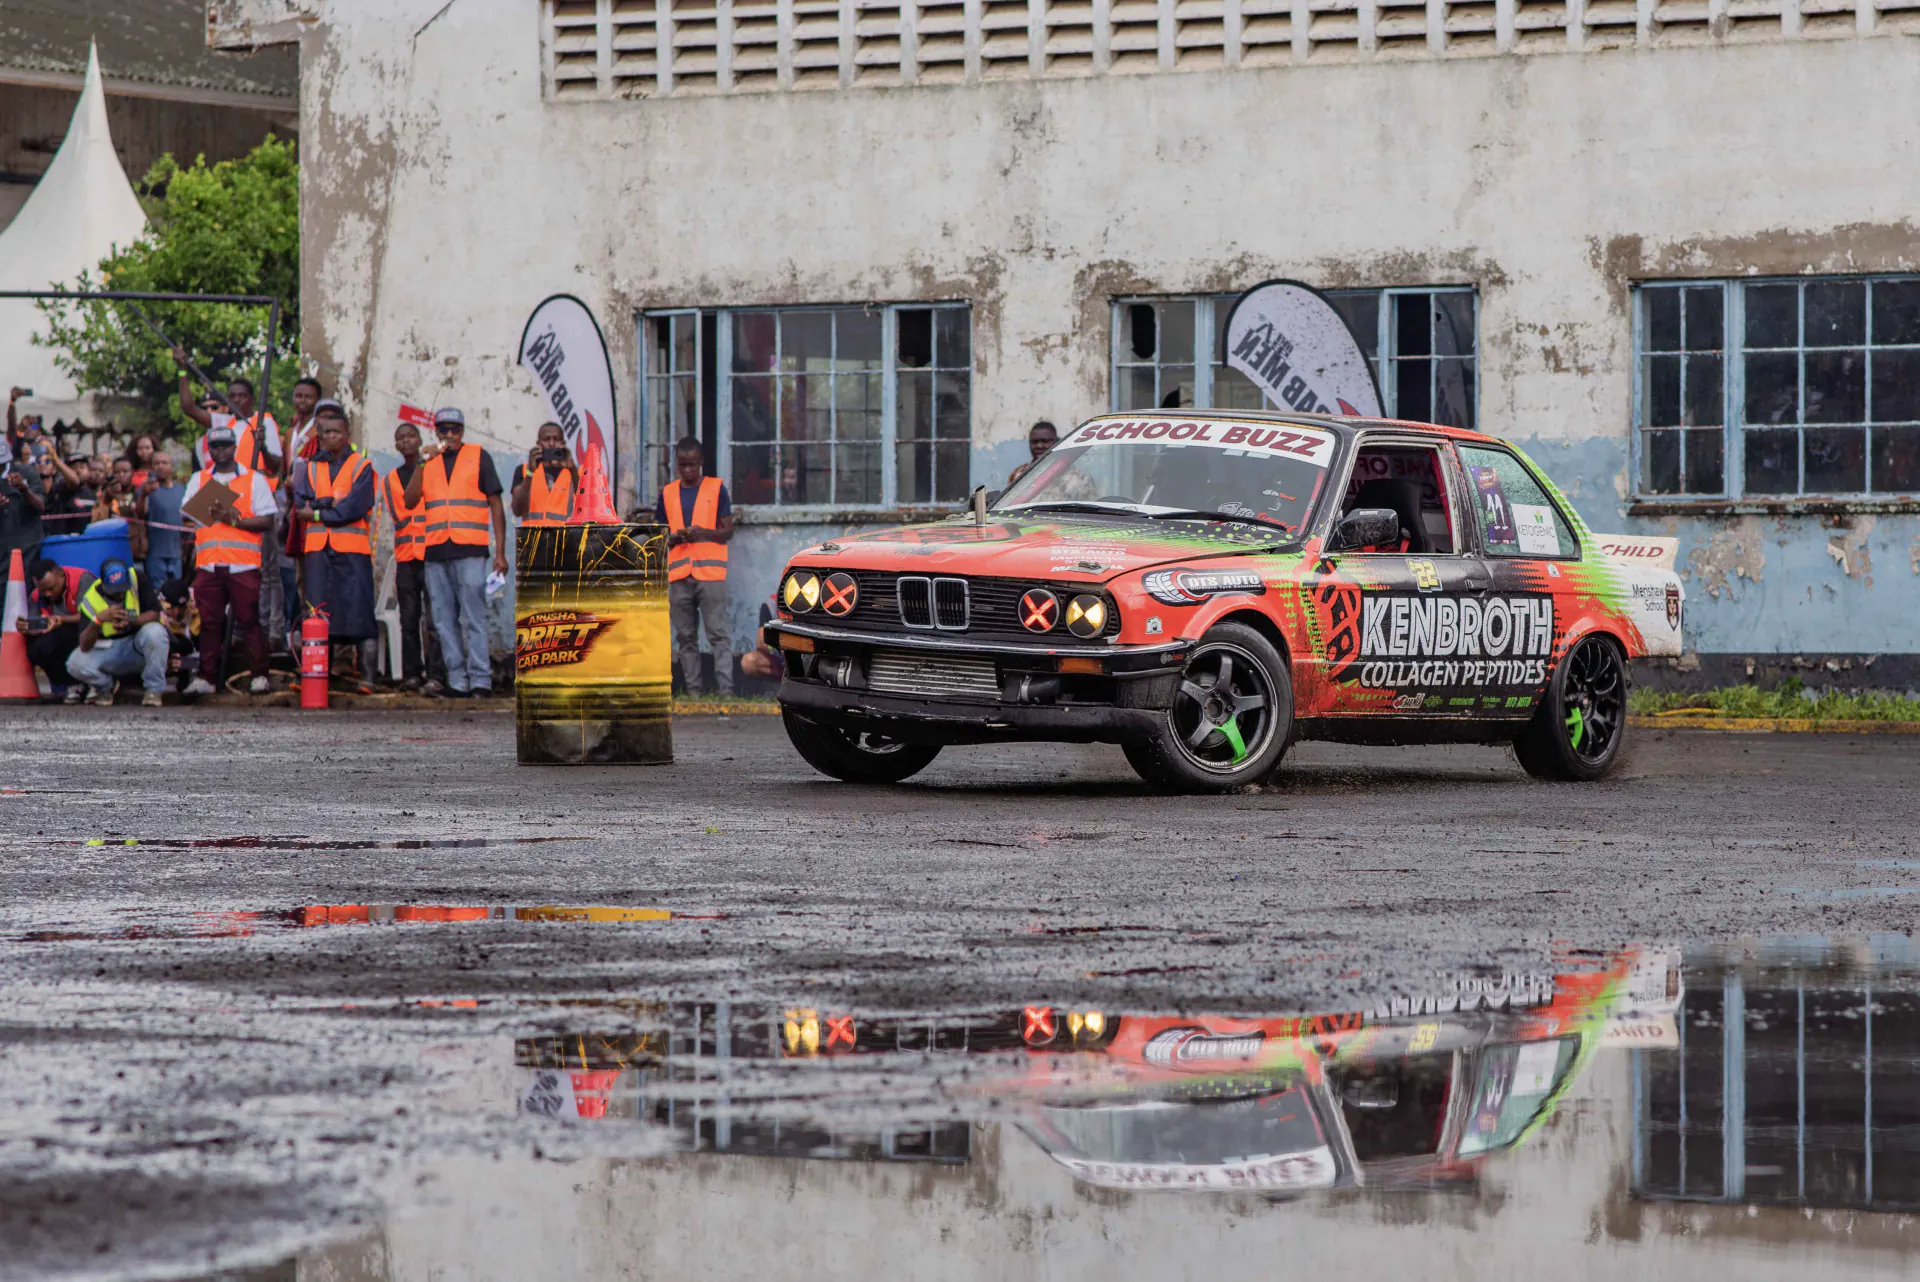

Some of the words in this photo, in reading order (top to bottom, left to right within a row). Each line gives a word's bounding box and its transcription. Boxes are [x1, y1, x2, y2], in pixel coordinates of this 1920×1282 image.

[1074, 422, 1212, 443] SCHOOL
[1219, 426, 1326, 457] BUZZ
[1187, 577, 1217, 587] DTS
[1222, 575, 1260, 585] AUTO
[1632, 584, 1665, 597] Merishaw
[529, 612, 577, 625] ARUSHA
[1360, 597, 1553, 657] KENBROTH
[516, 622, 600, 653] DRIFT
[518, 655, 539, 668] CAR
[540, 650, 580, 664] PARK
[1361, 661, 1459, 687] COLLAGEN
[1462, 660, 1546, 686] PEPTIDES
